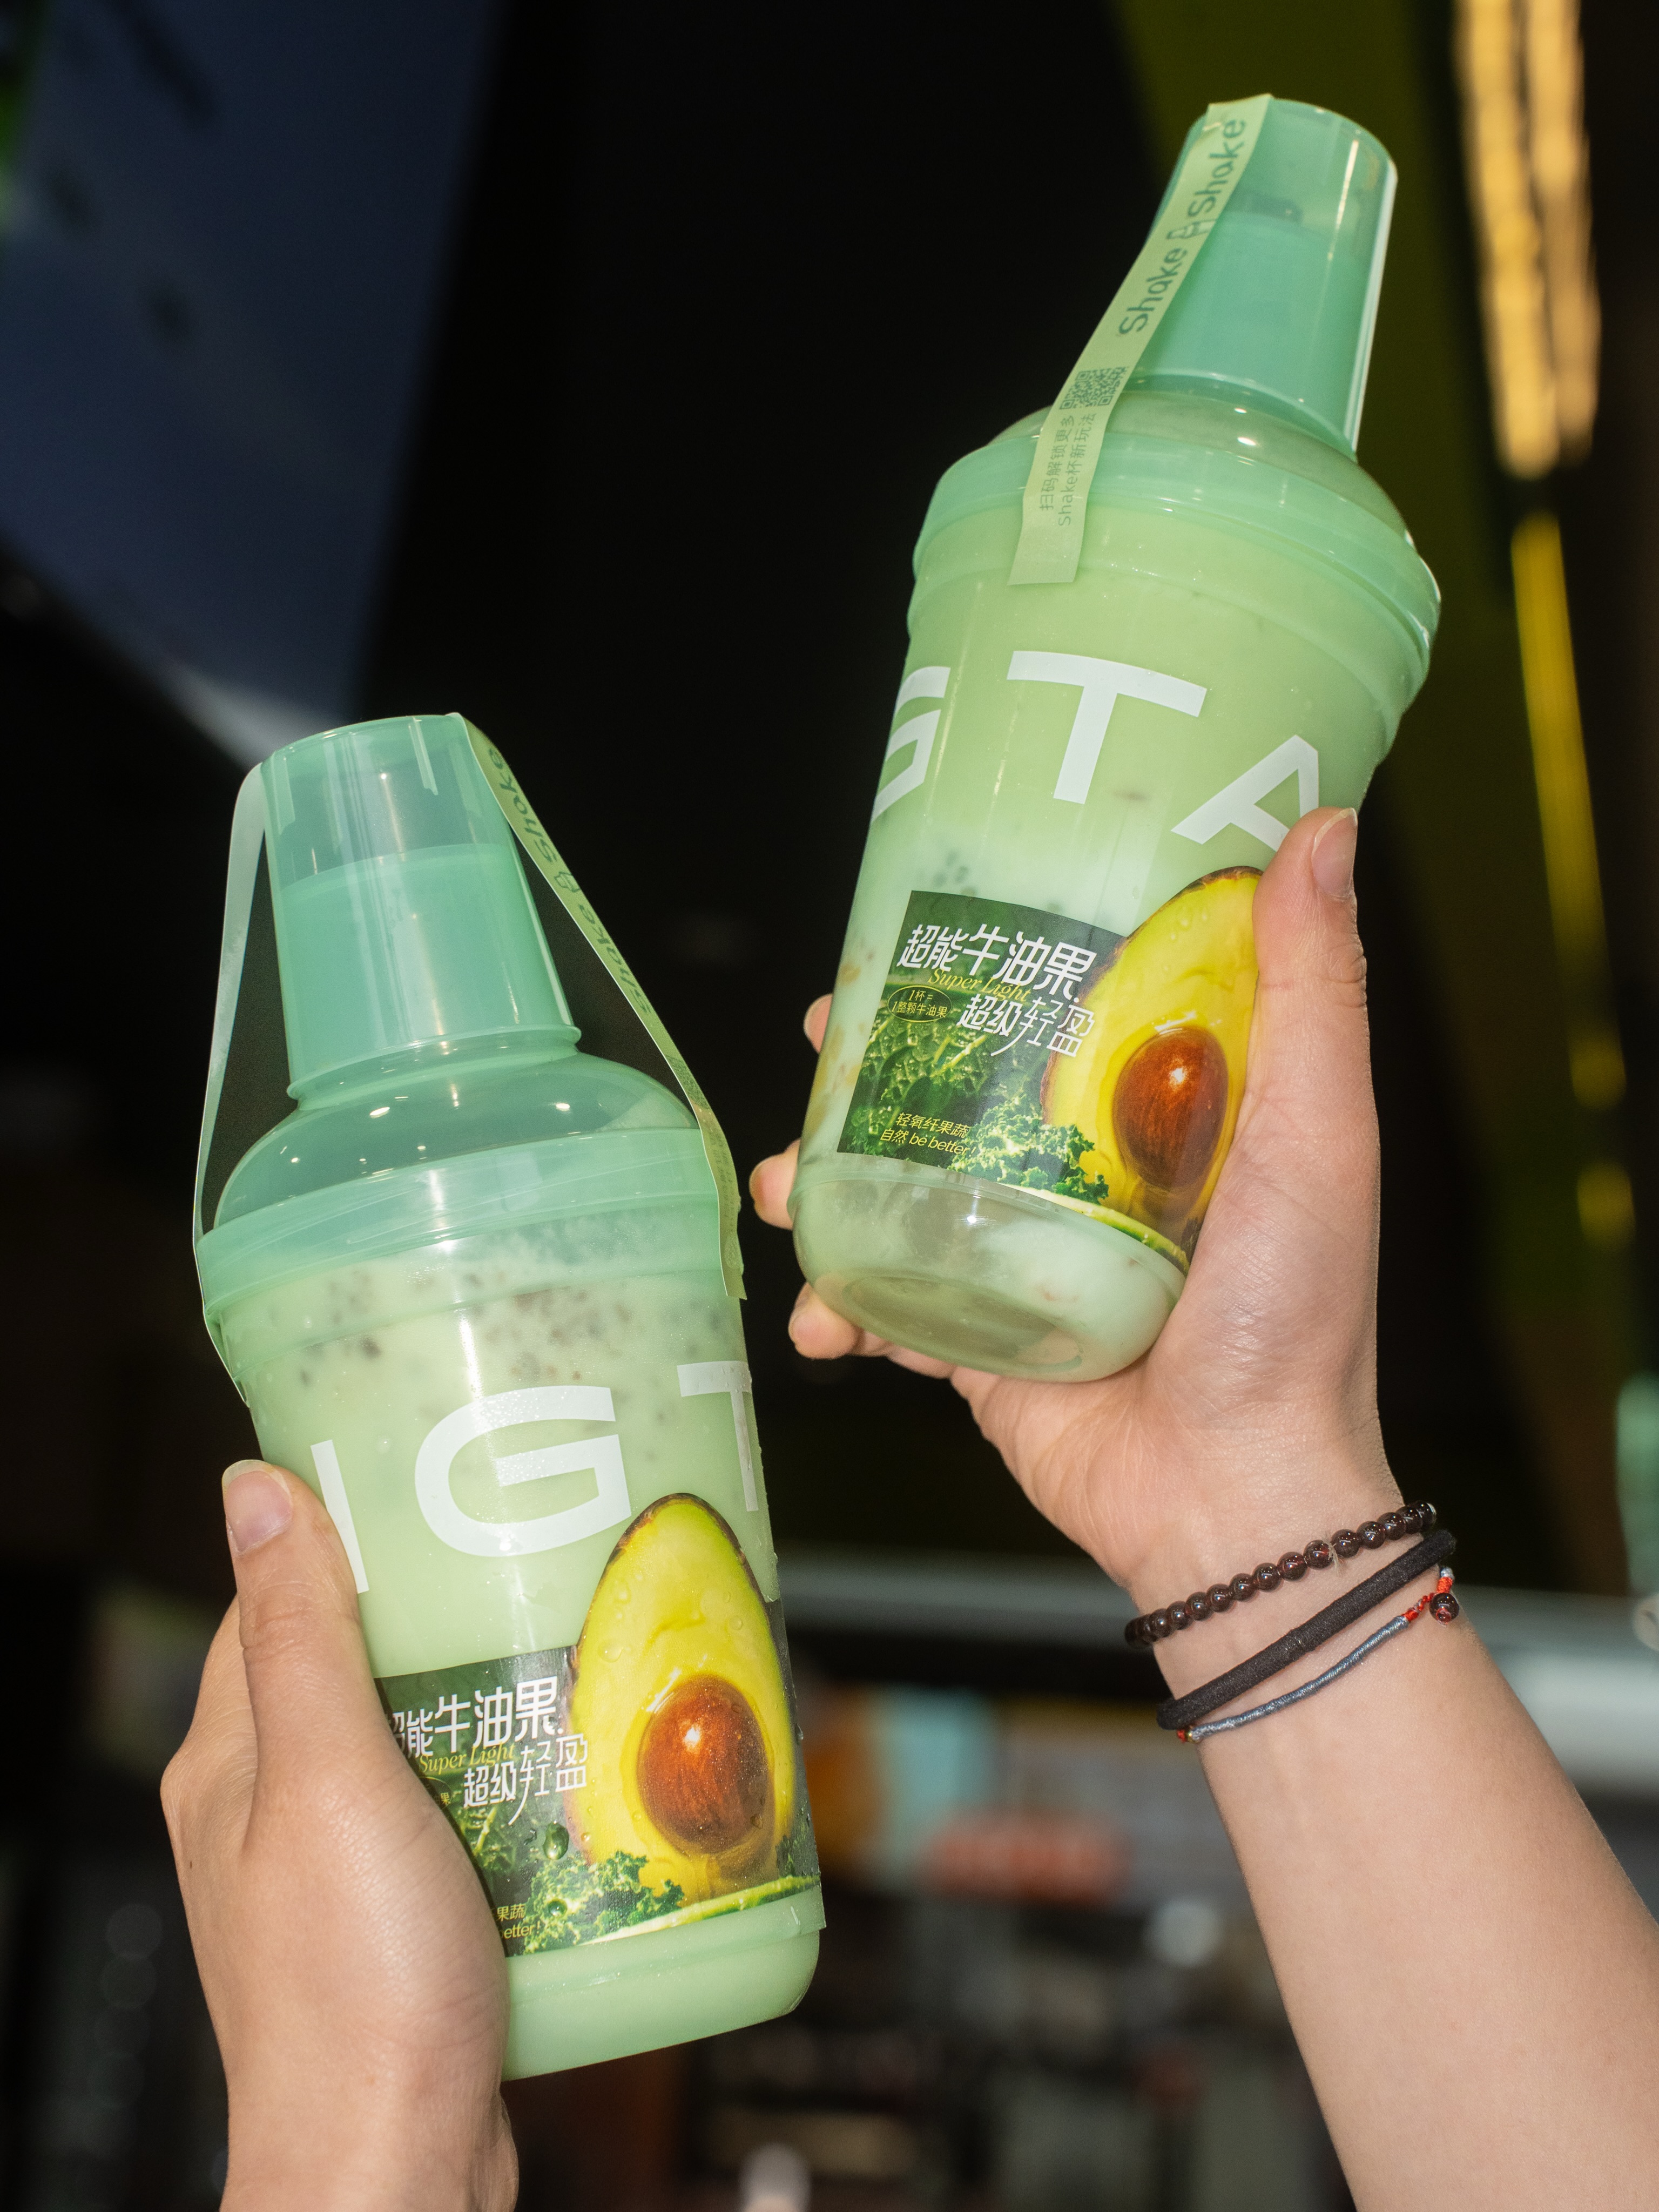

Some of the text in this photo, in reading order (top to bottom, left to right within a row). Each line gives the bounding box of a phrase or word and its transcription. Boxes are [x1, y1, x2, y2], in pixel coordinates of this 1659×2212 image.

[1119, 118, 1246, 335] Shake Shake
[1040, 415, 1075, 511] 扫码解锁更多
[1057, 413, 1097, 527] Shake杯新玩法
[488, 748, 652, 1014] Shake Shake
[928, 968, 1031, 1002] Super Light
[891, 1001, 948, 1019] 1整颗牛油果
[956, 993, 1096, 1057] 超级轻盈
[880, 1128, 909, 1144] 自然
[908, 1132, 927, 1147] be
[895, 1112, 970, 1139] 轻氧纤果蔬
[419, 1741, 516, 1775] Super Light
[463, 1733, 588, 1826] 超级轻盈
[501, 1920, 541, 1939] etter!
